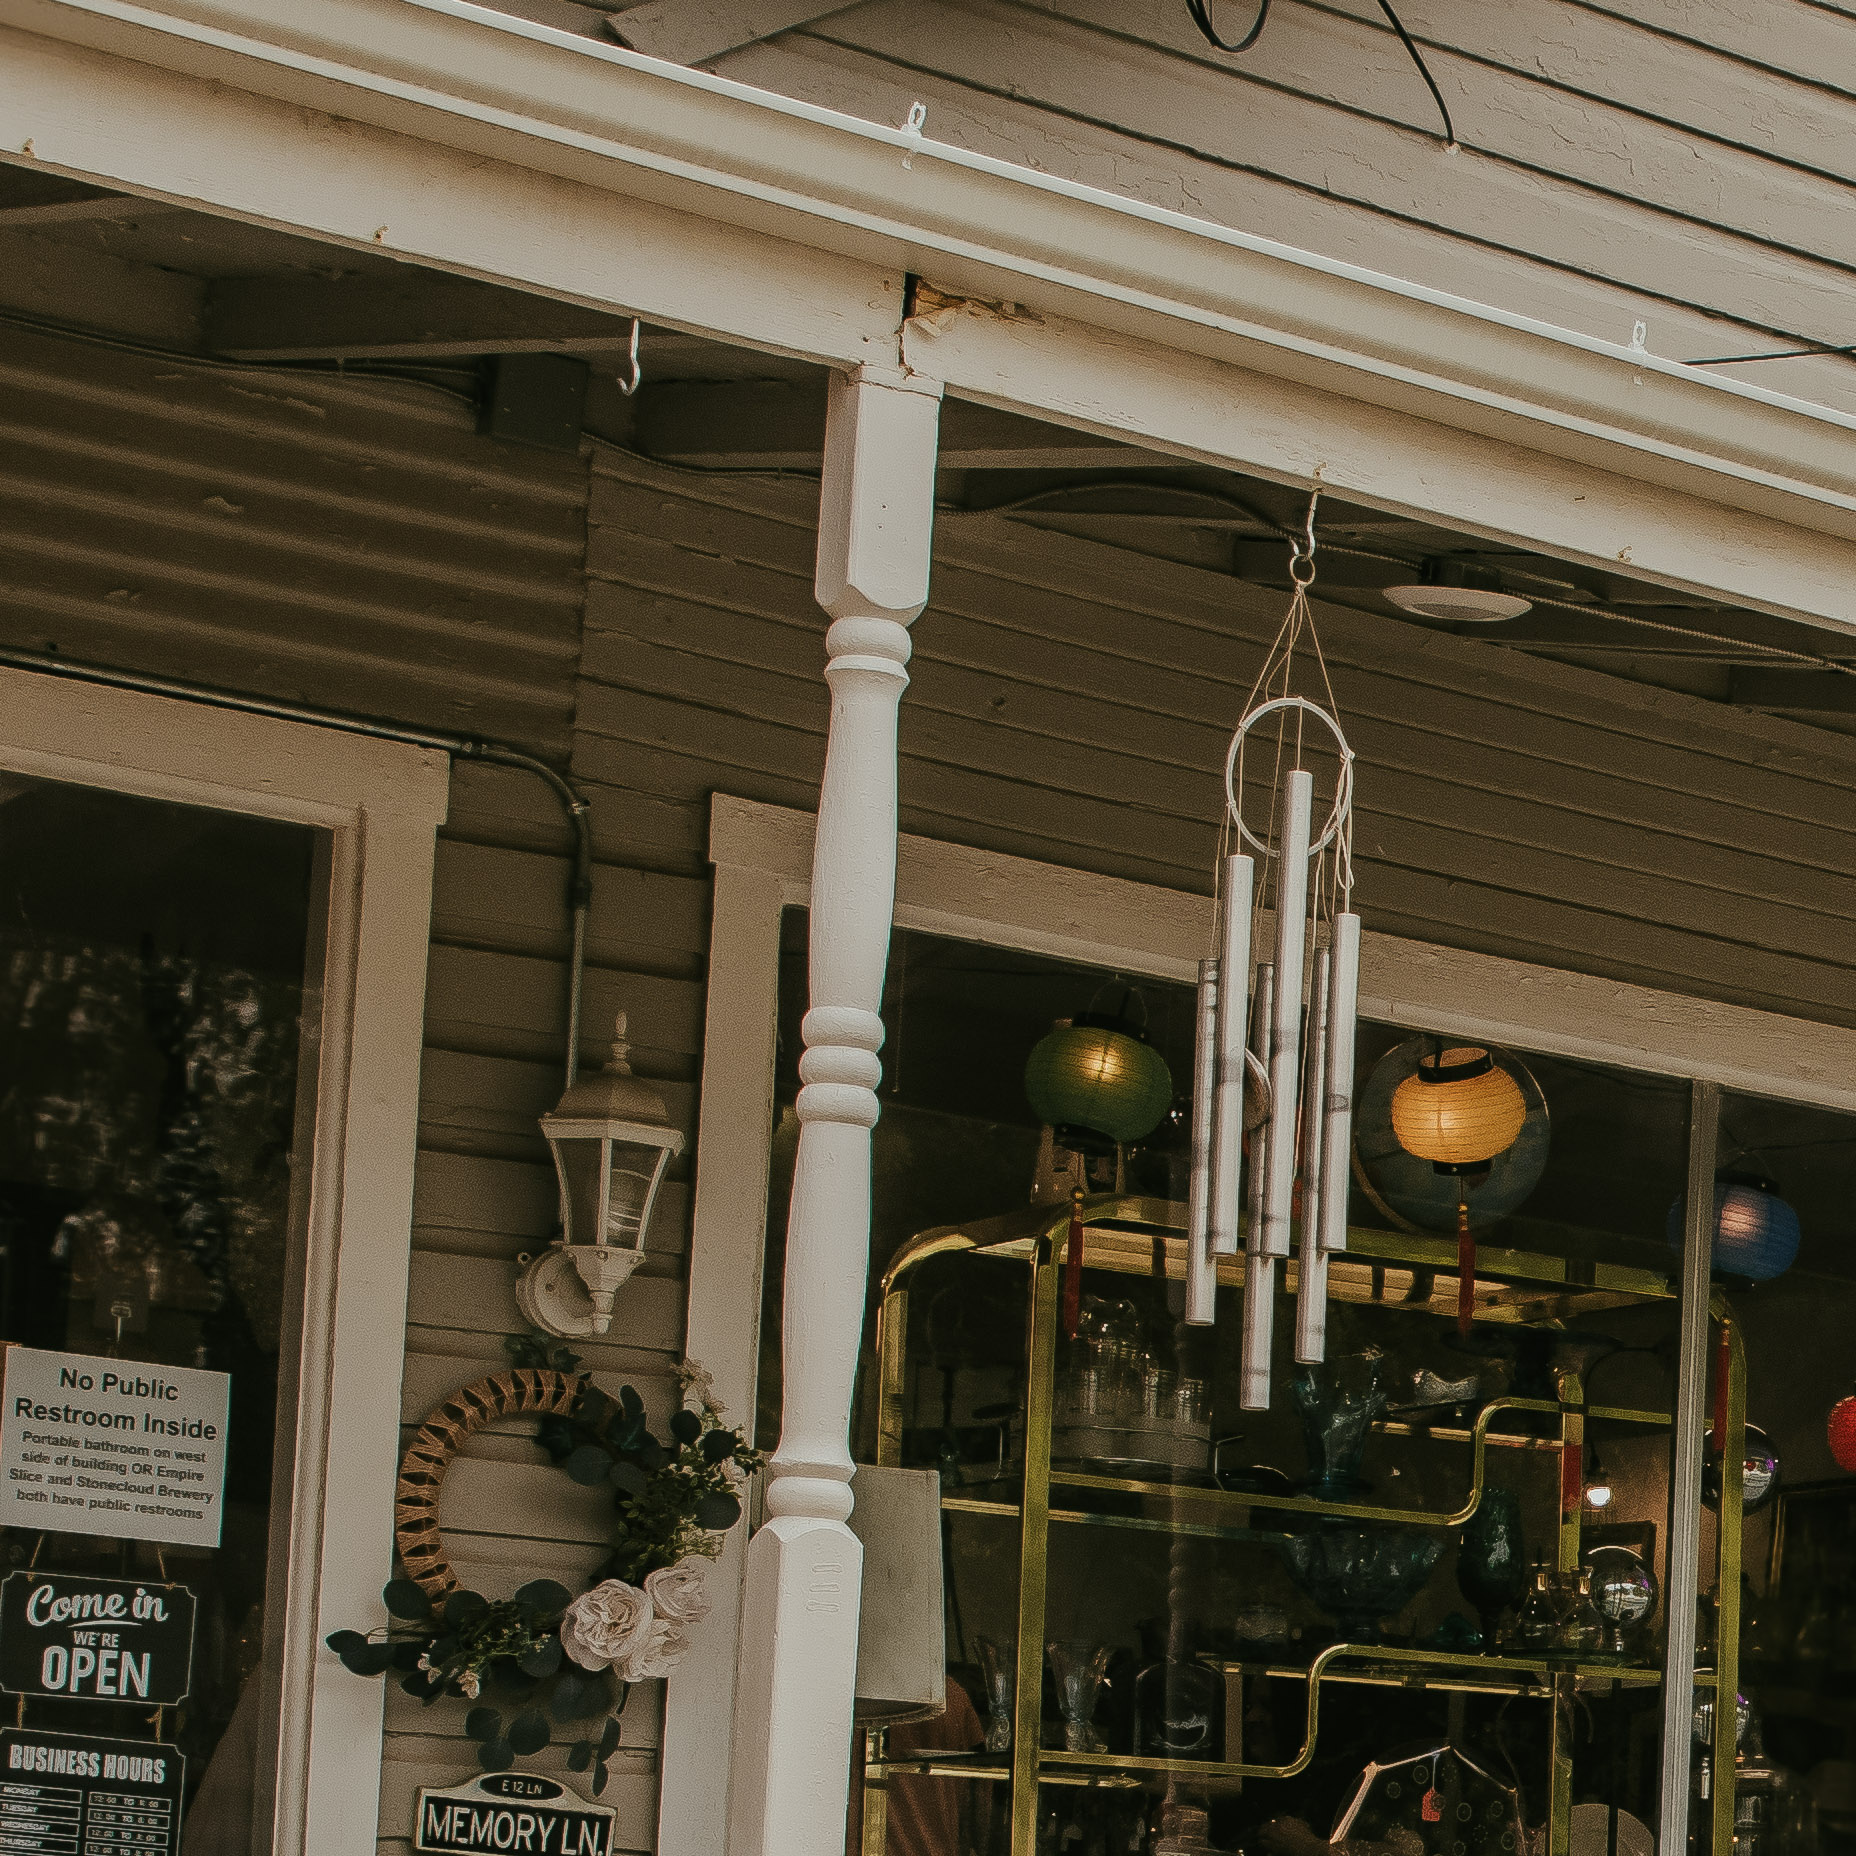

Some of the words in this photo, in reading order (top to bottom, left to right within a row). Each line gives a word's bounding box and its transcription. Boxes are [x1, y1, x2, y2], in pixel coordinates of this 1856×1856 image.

[59, 1367, 94, 1390] No
[101, 1372, 179, 1401] Public
[14, 1397, 136, 1431] Restroom
[143, 1413, 217, 1441] Inside
[22, 1430, 80, 1448] Portable
[84, 1437, 150, 1457] bathroom
[153, 1447, 171, 1459] on
[174, 1450, 207, 1463] west
[21, 1451, 50, 1465] side
[54, 1454, 70, 1466] of
[71, 1455, 127, 1475] building
[131, 1462, 153, 1476] OR
[157, 1465, 205, 1482] Empire
[9, 1467, 43, 1483] Slice
[48, 1473, 73, 1487] and
[75, 1475, 154, 1495] Stonecloud
[157, 1484, 214, 1504] Brewery
[16, 1488, 48, 1502] both
[52, 1492, 85, 1506] have
[88, 1496, 131, 1512] public
[134, 1503, 204, 1519] restrooms
[26, 1584, 127, 1627] Come
[132, 1588, 169, 1622] in
[73, 1630, 120, 1648] WE'RE
[41, 1645, 151, 1697] OPEN
[9, 1744, 100, 1777] BUSINESS
[103, 1753, 165, 1784] HOURS
[502, 1780, 510, 1792] E
[513, 1781, 524, 1794] 12
[527, 1783, 543, 1795] LN
[427, 1803, 556, 1852] MEMORY
